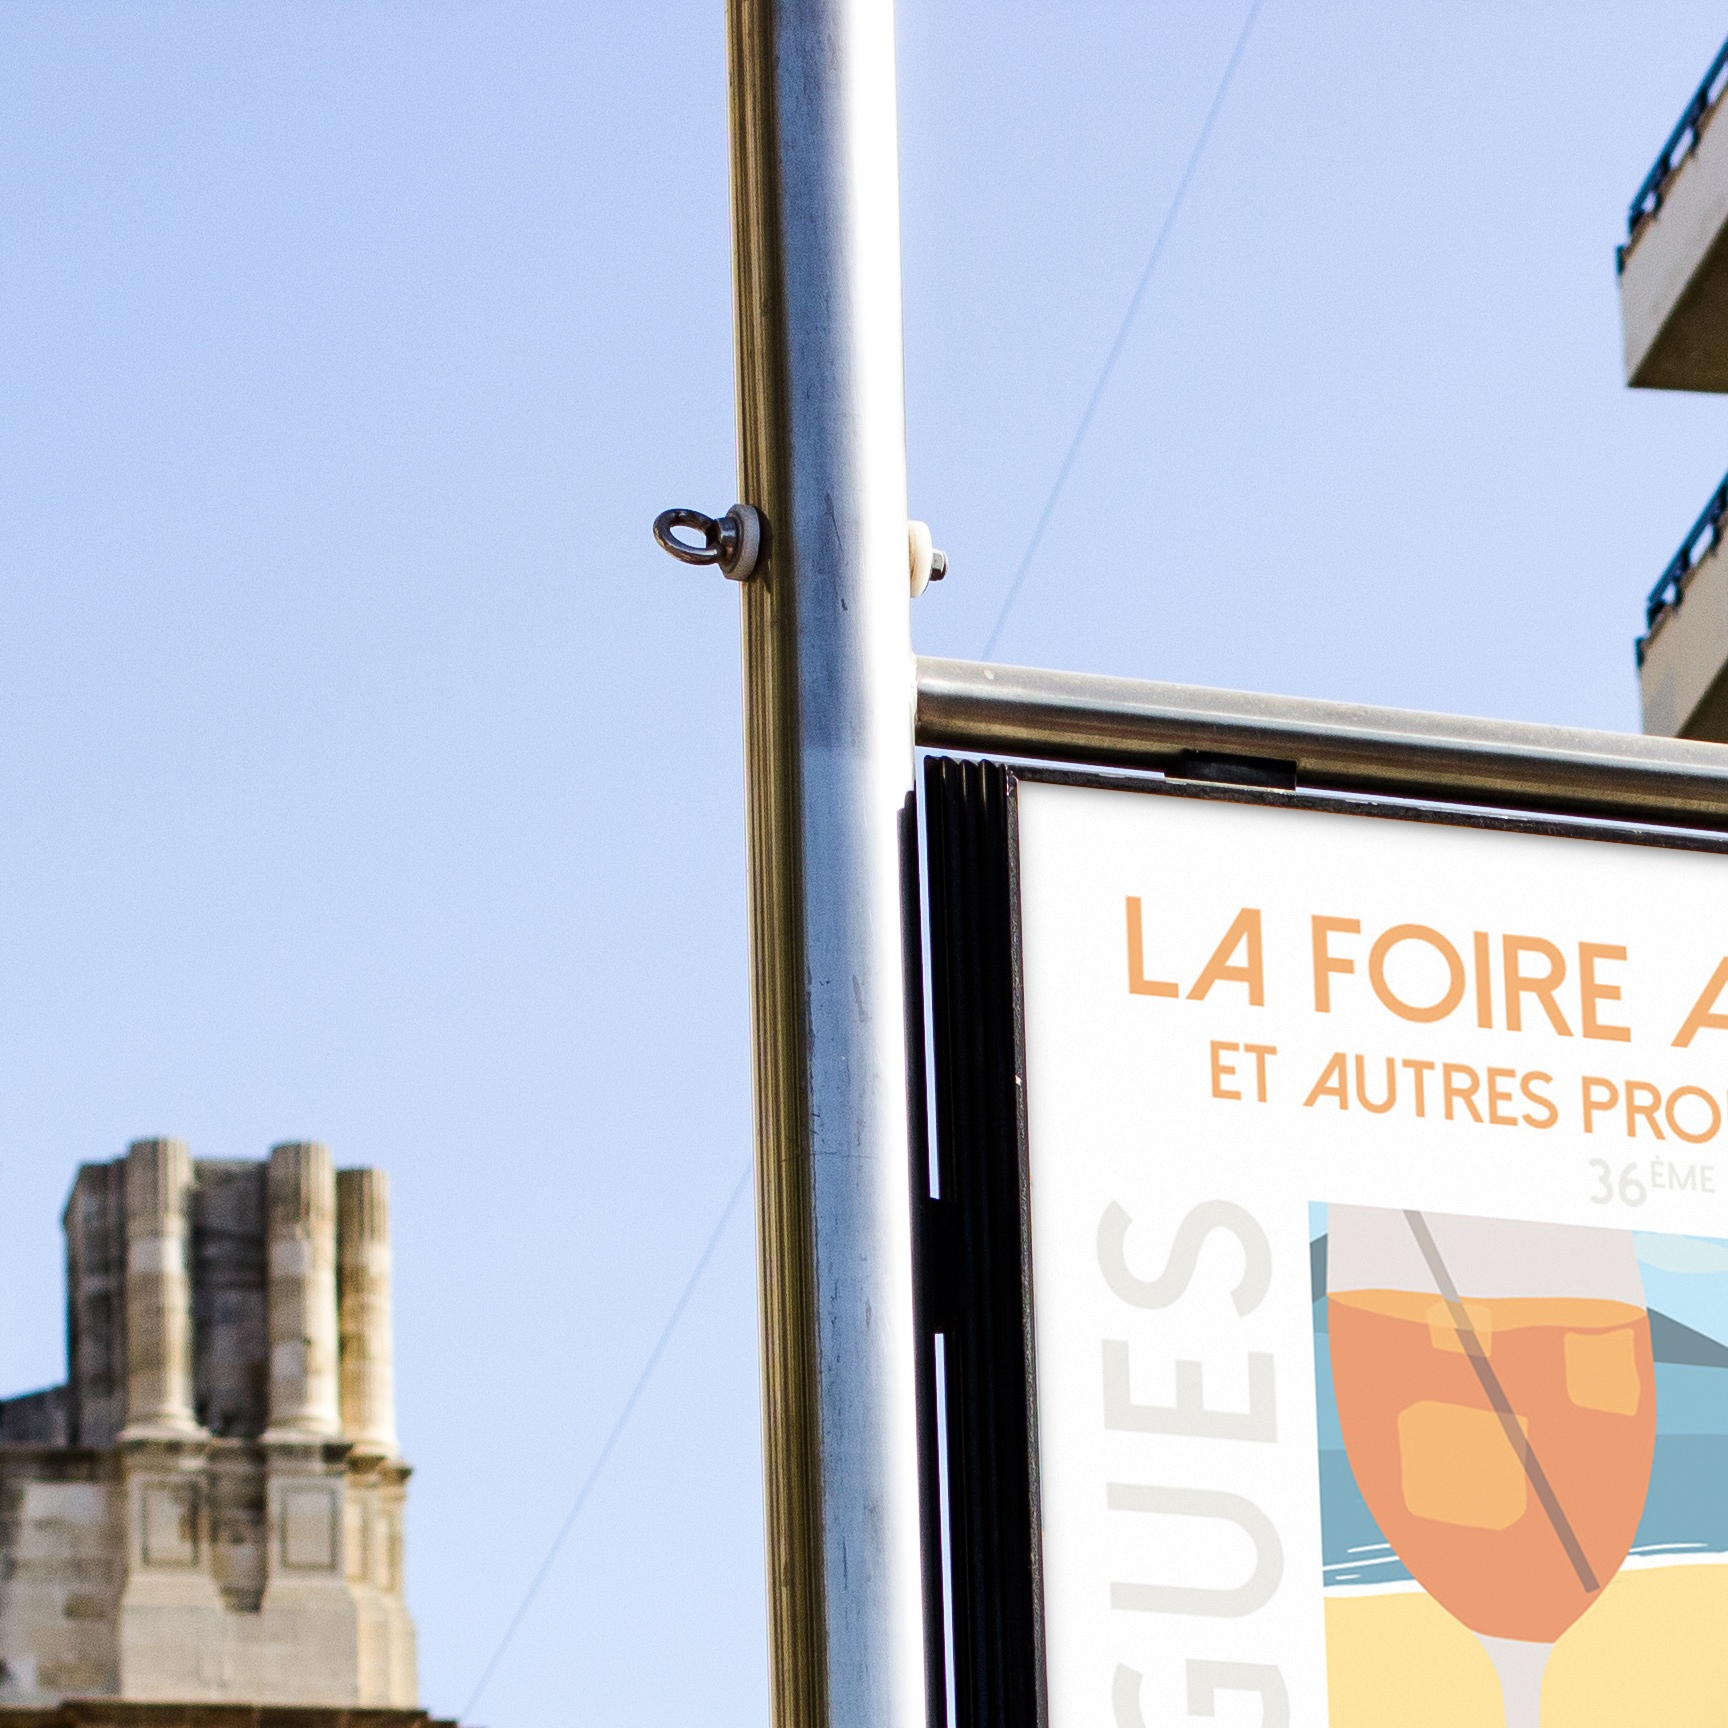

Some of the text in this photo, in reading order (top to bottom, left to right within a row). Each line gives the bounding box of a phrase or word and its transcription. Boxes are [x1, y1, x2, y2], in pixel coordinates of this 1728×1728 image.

[1125, 896, 1265, 1007] LA
[1311, 915, 1631, 1043] FOIRE
[1210, 1040, 1277, 1103] ET
[1303, 1052, 1559, 1129] AUTRES
